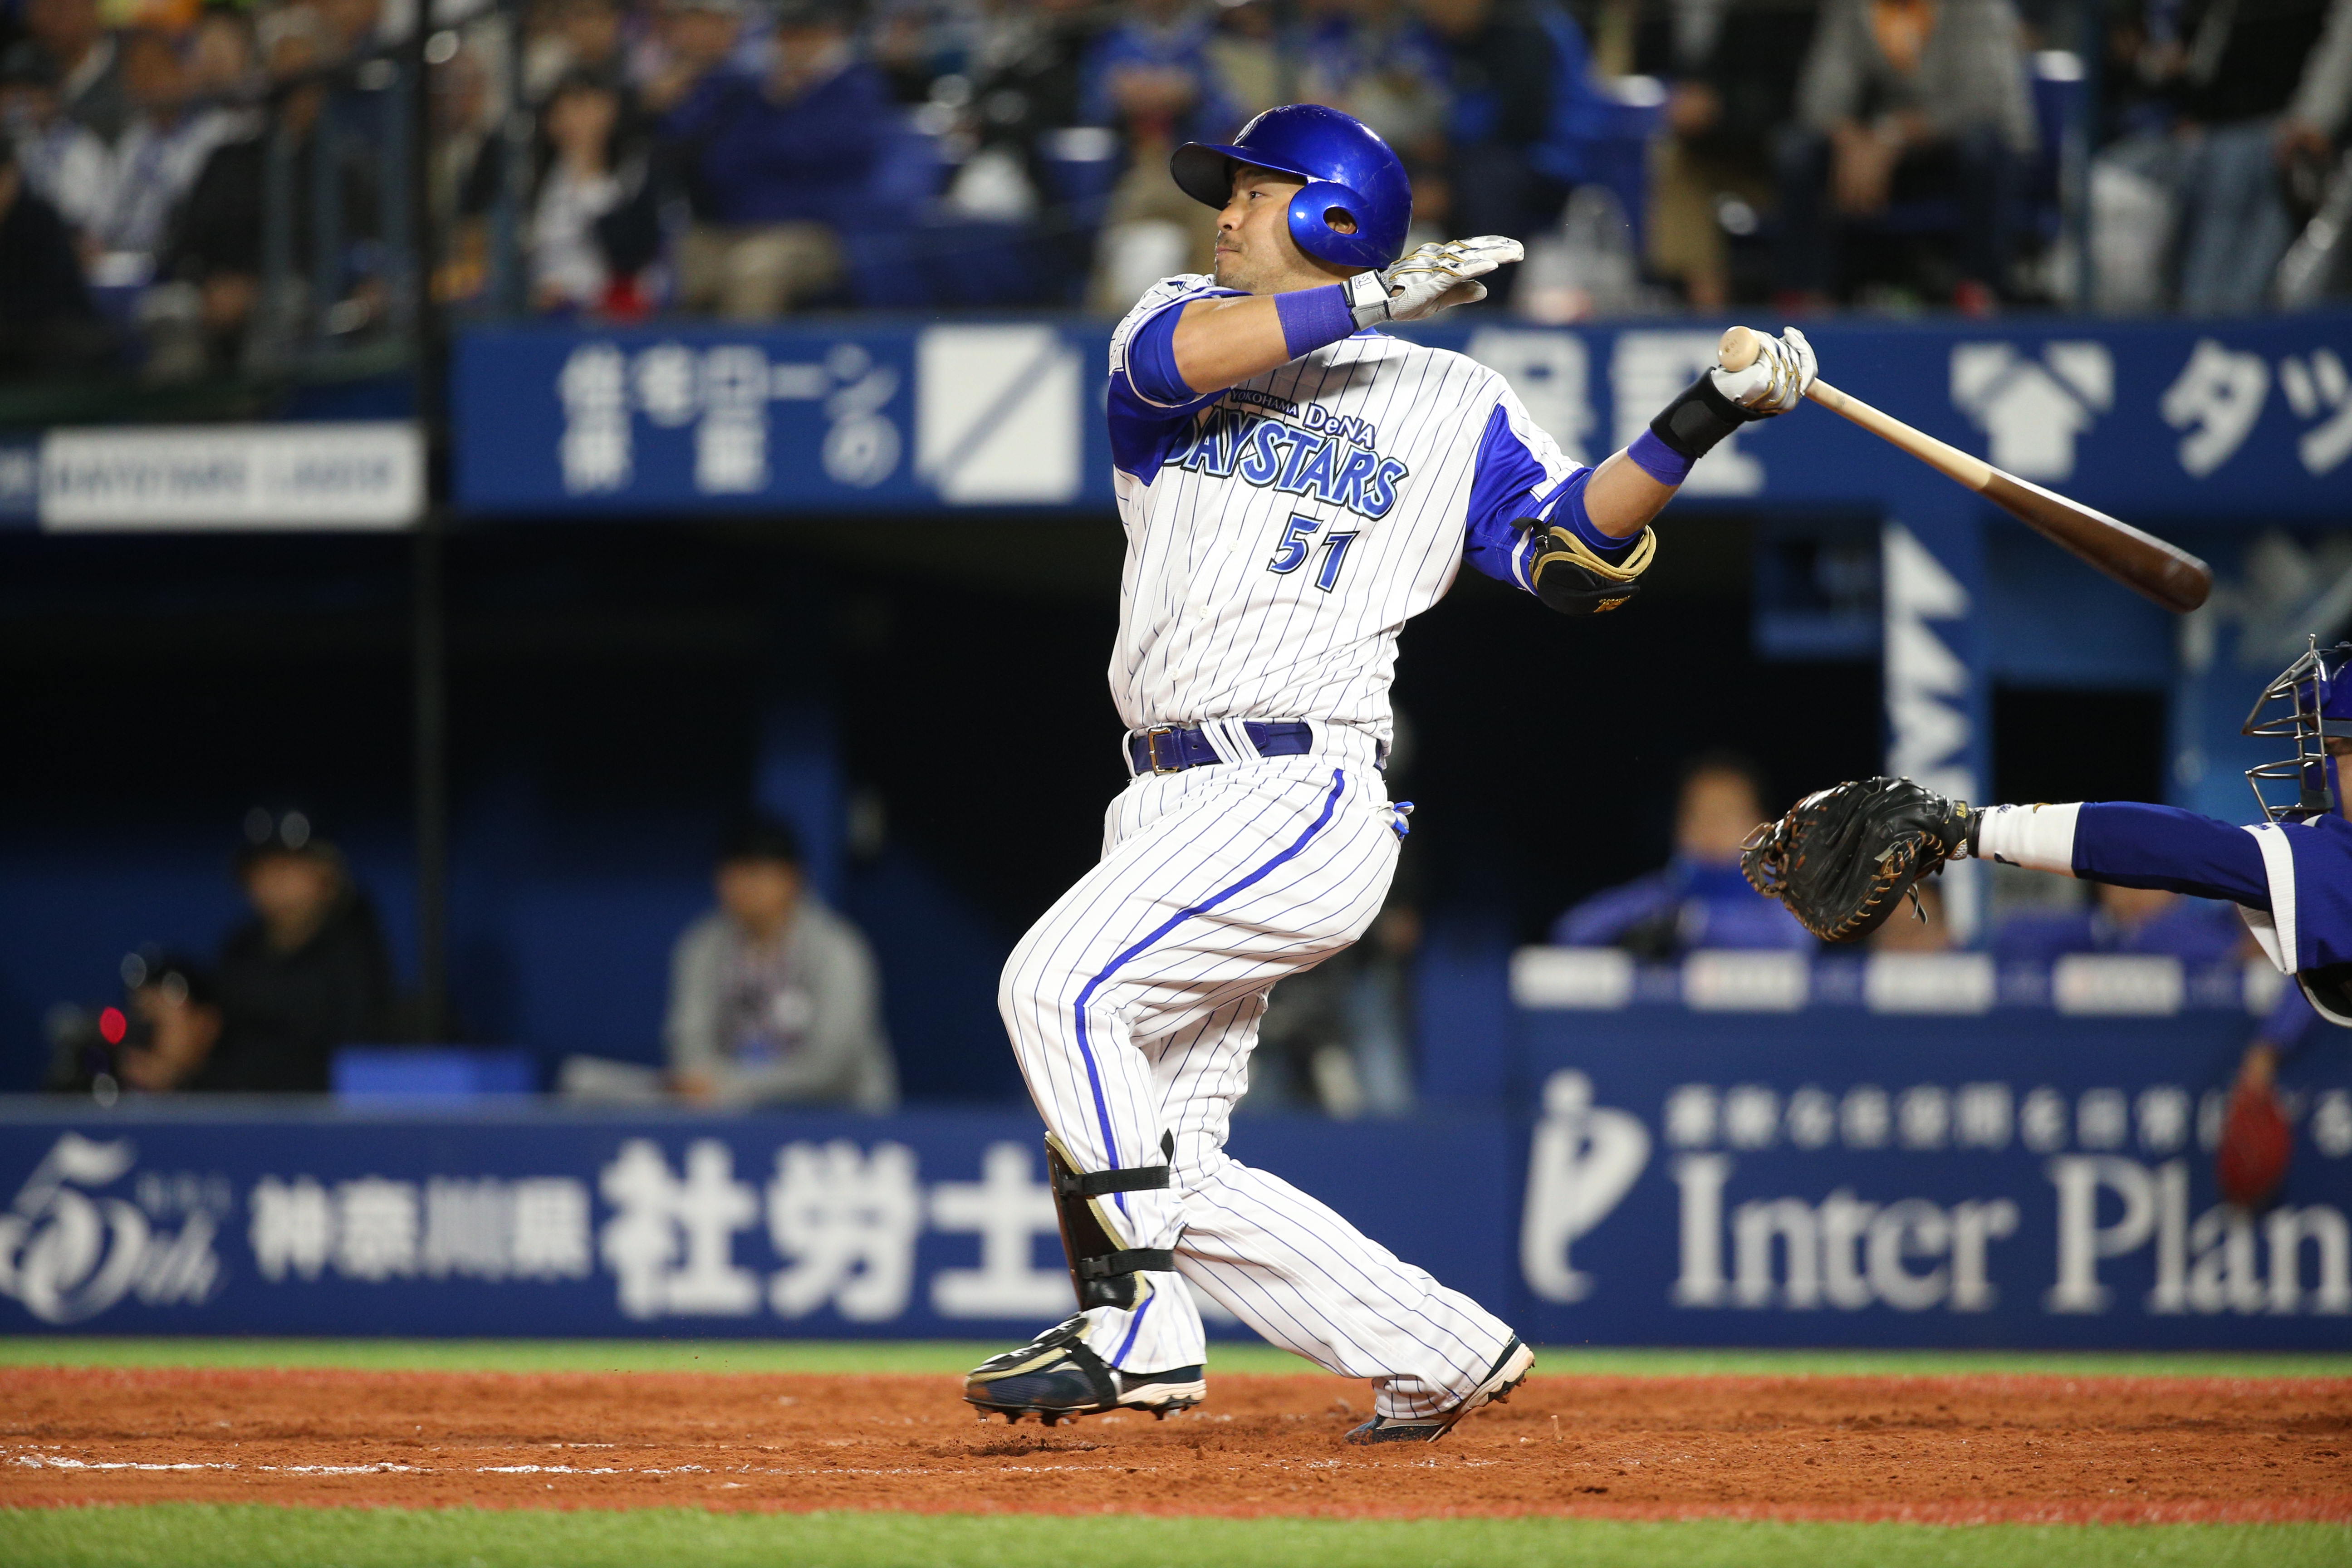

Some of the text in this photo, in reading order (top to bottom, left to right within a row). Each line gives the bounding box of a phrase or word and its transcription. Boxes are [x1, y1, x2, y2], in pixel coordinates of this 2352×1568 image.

[1230, 388, 1375, 449] YOKOHAMA DeNA
[1267, 512, 1359, 593] 51
[1666, 1148, 2352, 1316] Inter Plan
